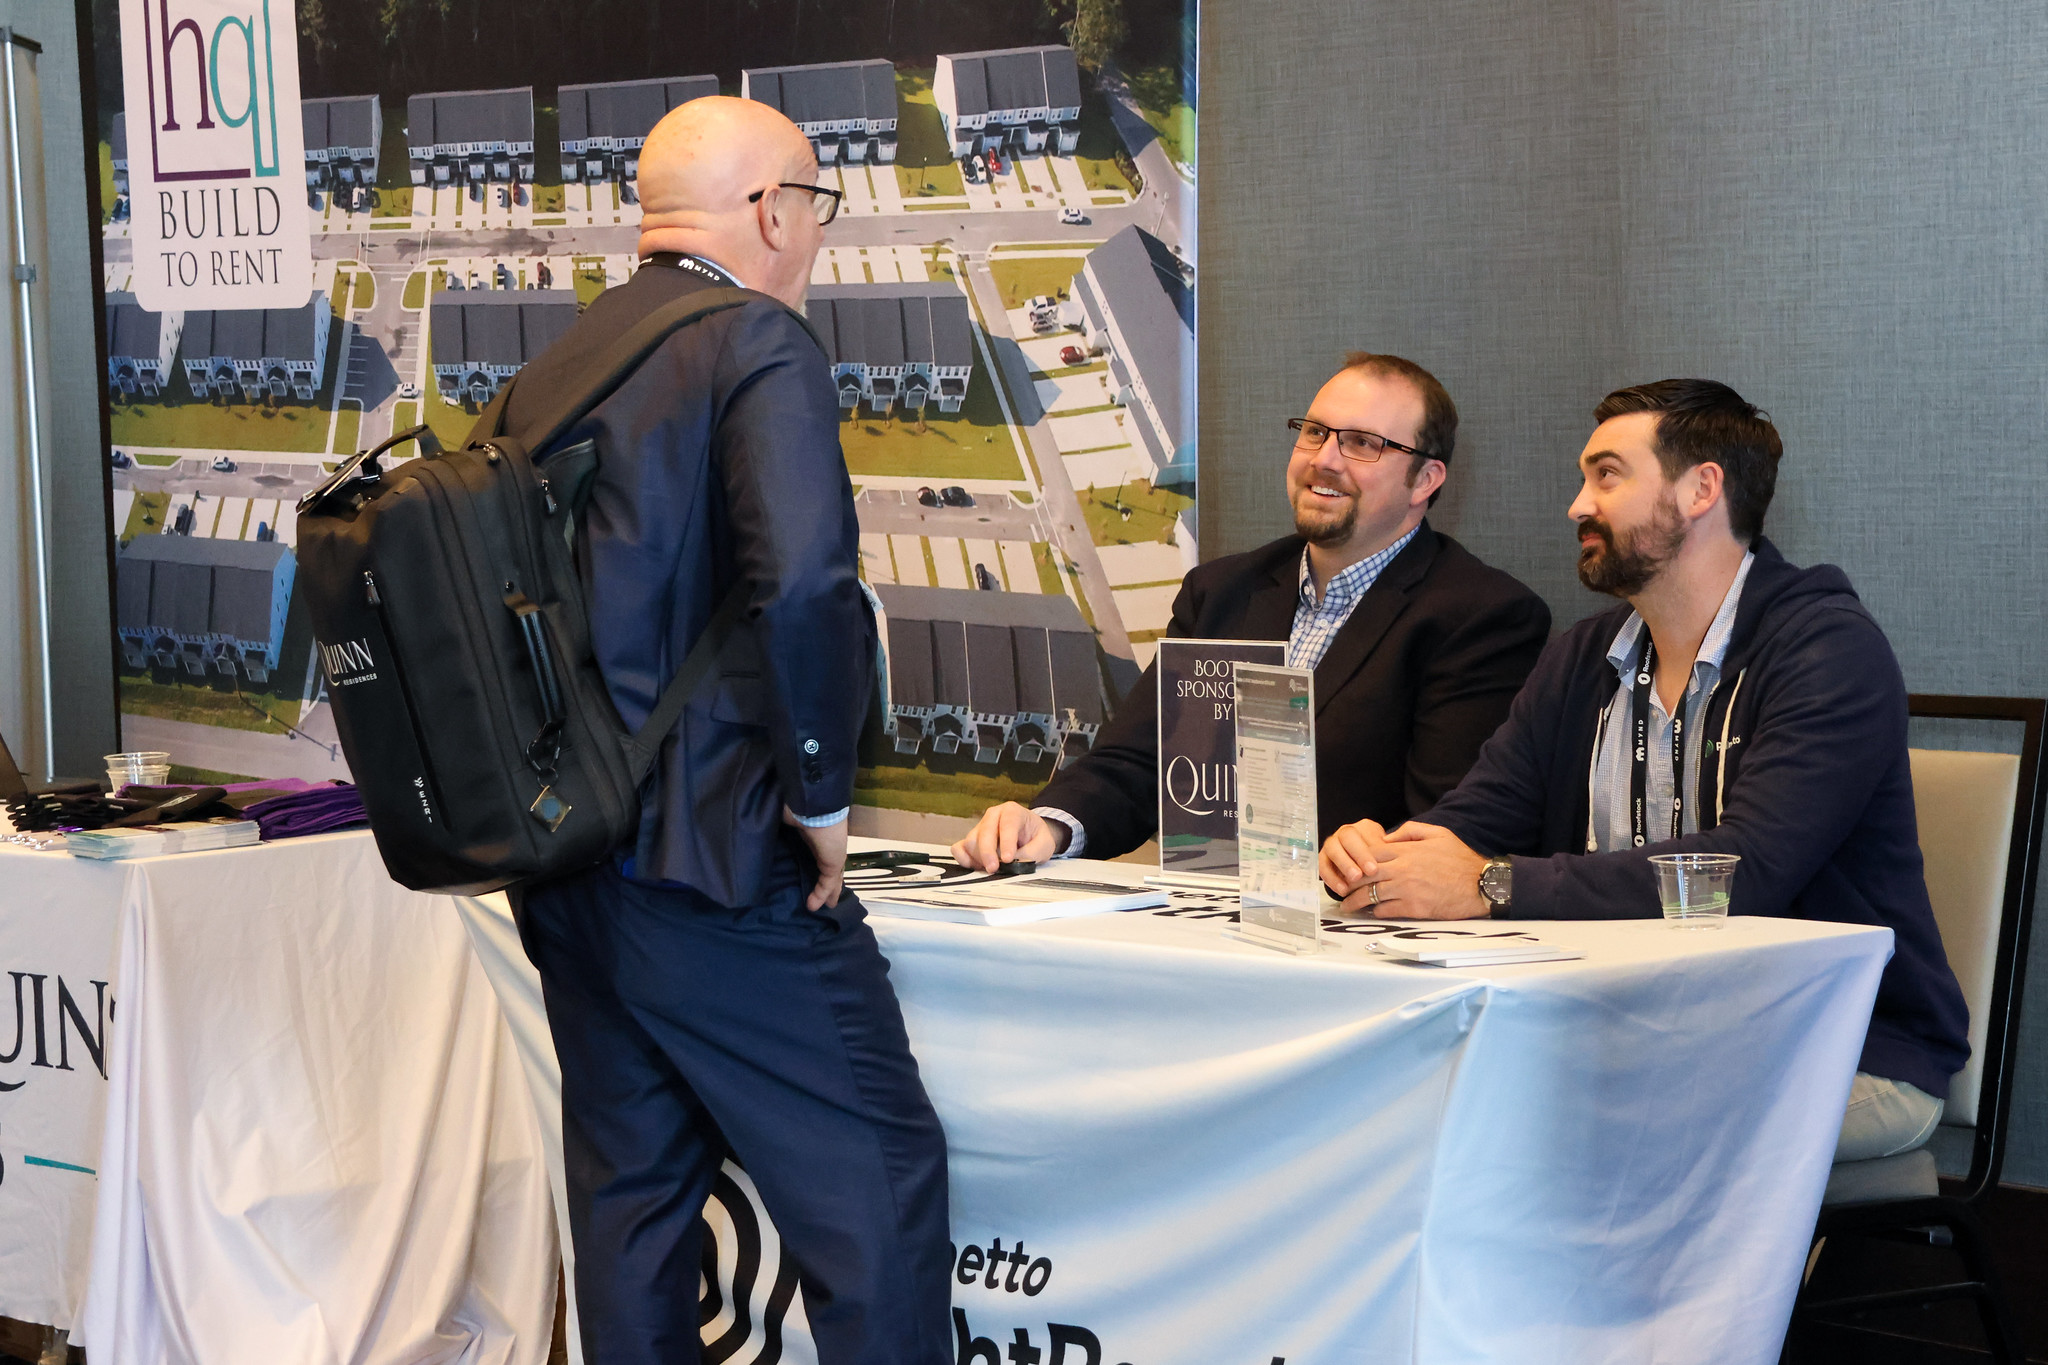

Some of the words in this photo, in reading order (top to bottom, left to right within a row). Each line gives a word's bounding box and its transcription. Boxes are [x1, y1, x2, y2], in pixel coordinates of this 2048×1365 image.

[158, 186, 281, 240] BUILD
[161, 251, 198, 287] TO
[211, 249, 282, 286] RENT
[694, 264, 720, 281] MYND
[1194, 659, 1238, 677] BOO
[1177, 680, 1235, 699] SPONSO
[1214, 703, 1233, 720] BY
[1223, 810, 1239, 818] RES
[950, 1237, 1053, 1297] etto
